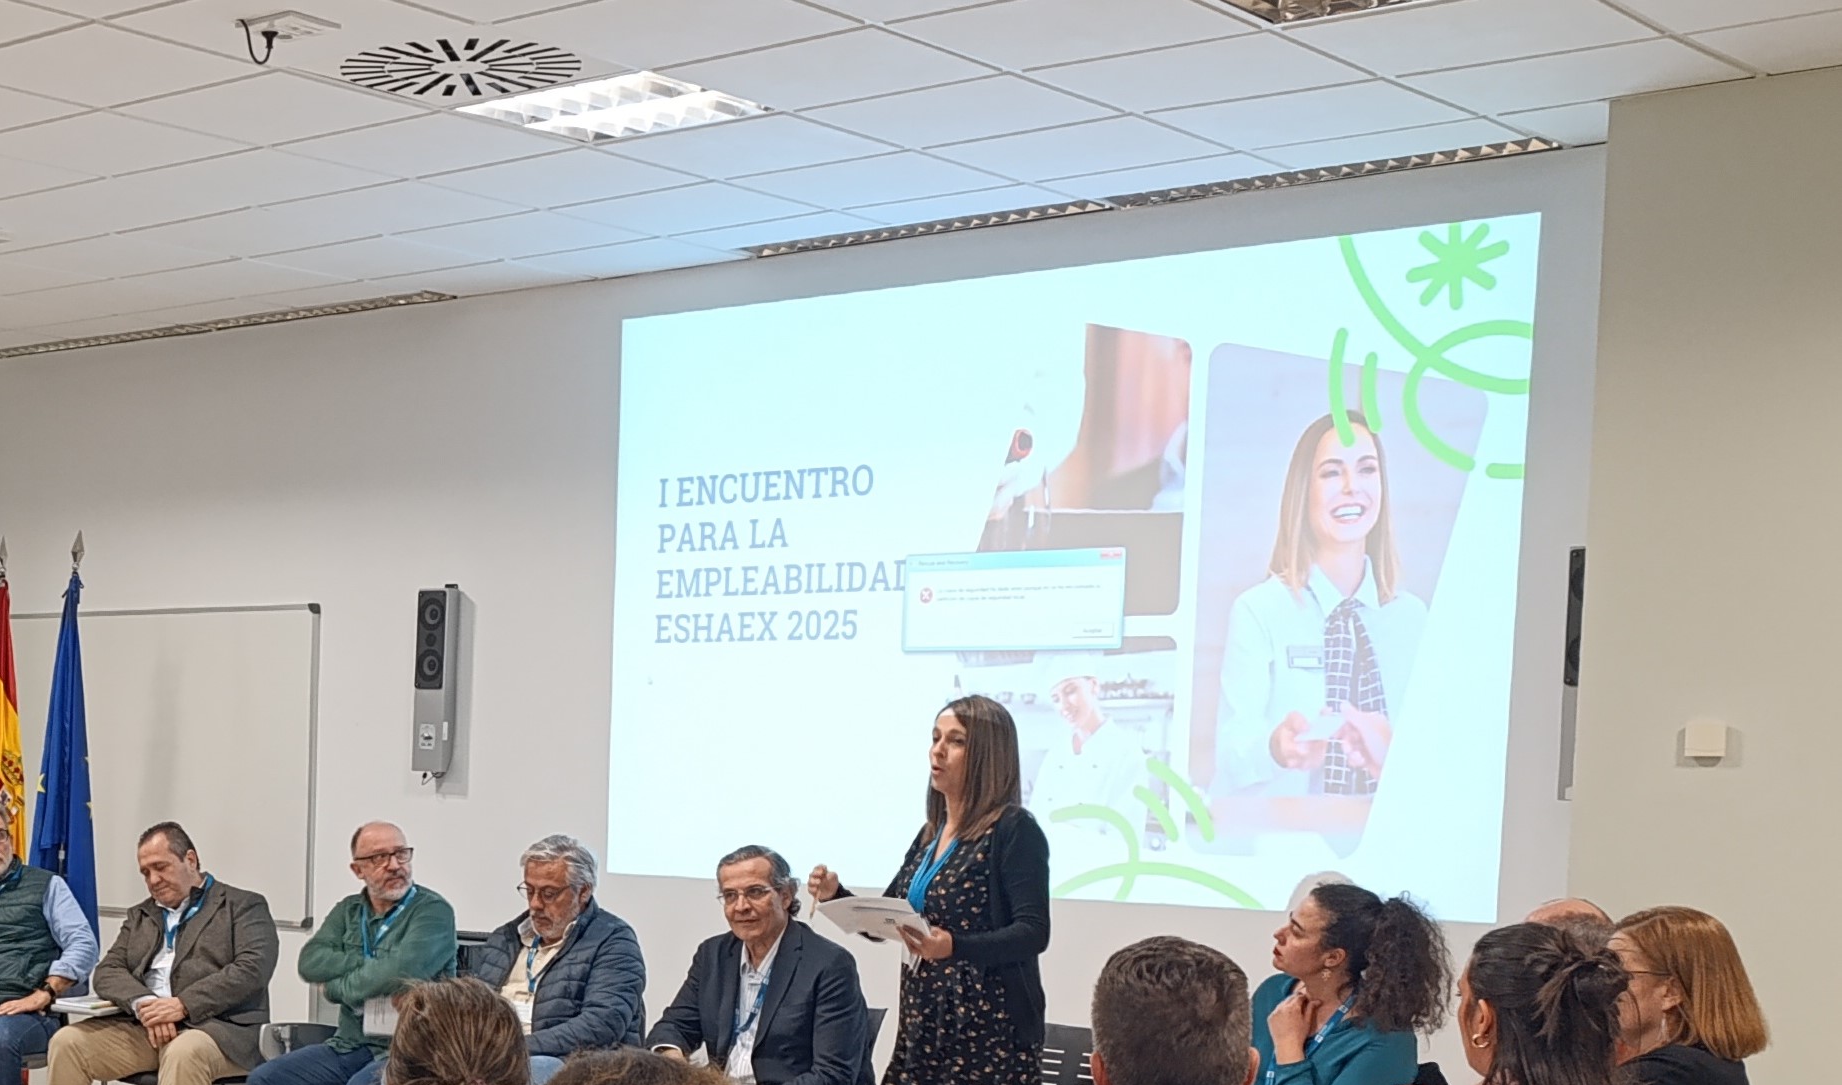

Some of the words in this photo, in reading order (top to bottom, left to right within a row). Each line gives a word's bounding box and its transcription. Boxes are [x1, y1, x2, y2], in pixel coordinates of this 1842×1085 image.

[657, 477, 670, 509] I
[675, 463, 875, 508] ENCUENTRO
[657, 519, 740, 554] PARA
[748, 517, 789, 549] LA
[654, 610, 778, 644] ESHAEX
[787, 609, 858, 641] 2025
